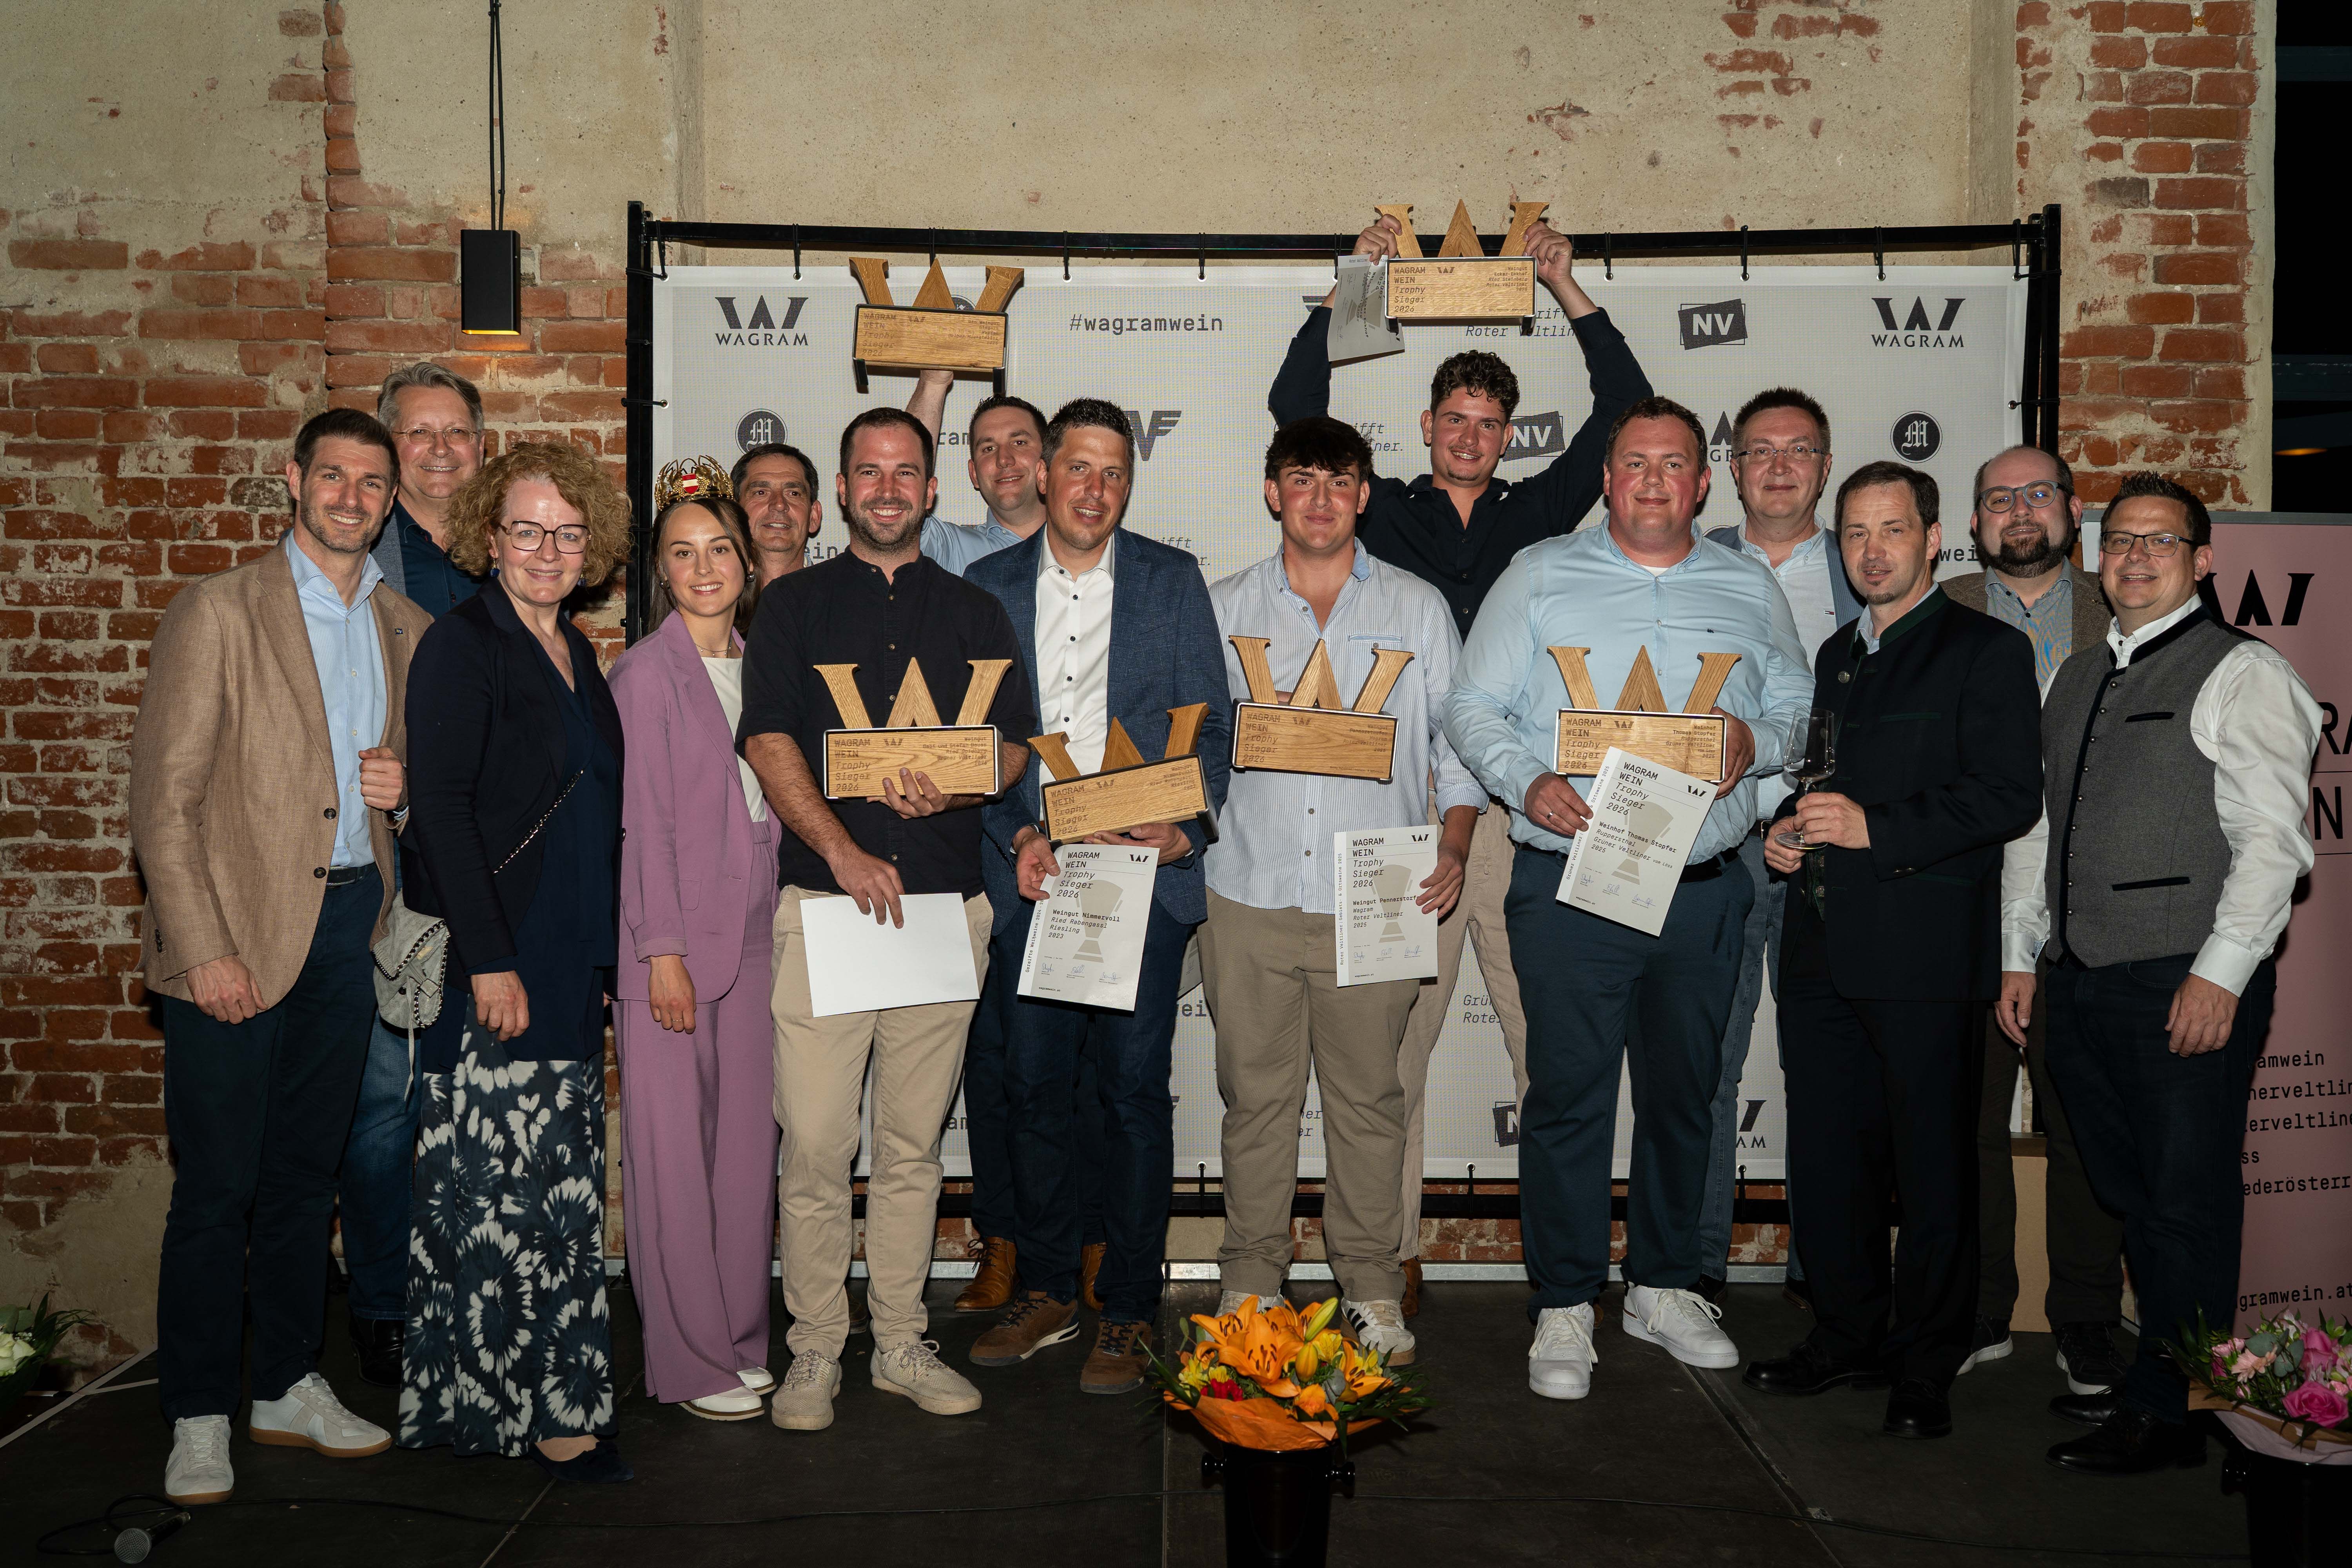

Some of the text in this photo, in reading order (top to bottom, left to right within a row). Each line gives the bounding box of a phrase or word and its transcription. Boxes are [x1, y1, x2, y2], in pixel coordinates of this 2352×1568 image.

[1070, 314, 1222, 335] #wagramwein
[1693, 314, 1734, 335] NV
[1466, 326, 1508, 336] Roter
[715, 333, 808, 345] WAGRAM
[1871, 334, 1964, 347] WAGRAM
[1353, 423, 1385, 434] ifft
[1511, 426, 1552, 447] NV
[1247, 713, 1280, 722] WAGRAM
[1566, 718, 1601, 726] WAGRAM
[1246, 722, 1268, 732] WEIN
[1566, 728, 1589, 737] WEIN
[835, 739, 870, 747] WAGRAM
[1245, 733, 1279, 744] Trophy
[1244, 744, 1278, 754] Sieger
[1566, 739, 1600, 750] Trophy
[835, 750, 859, 758] WEIN
[1243, 754, 1265, 763] 2026
[1565, 750, 1600, 760] Sieger
[836, 761, 871, 769] Trophy
[1564, 760, 1587, 769] 2026
[1623, 762, 1658, 780] WAGRAM
[835, 772, 871, 781] Sieger
[1619, 771, 1643, 786] WEIN
[835, 784, 858, 792] 2026
[1051, 785, 1085, 798] WAGRAM
[1615, 782, 1649, 800] Trophy
[1052, 797, 1074, 807] WEIN
[1611, 792, 1645, 810] Sieger
[1054, 805, 1087, 817] Trophy
[1606, 802, 1630, 815] 2026
[1055, 814, 1088, 826] Sieger
[1057, 825, 1078, 835] 2026
[1352, 837, 1384, 846] WAGRAM
[1596, 829, 1635, 847] Ruppersthal
[1599, 821, 1677, 853] Weinhof Thomas Stopfer
[1352, 849, 1374, 857] WEIN
[1591, 844, 1606, 853] 2025
[1619, 845, 1651, 861] Veltliner
[1353, 858, 1384, 867] Trophy
[1063, 871, 1096, 880] Trophy
[1353, 869, 1384, 878] Sieger
[1060, 880, 1093, 889] Sieger
[1353, 879, 1373, 888] 2026
[1057, 889, 1080, 898] 2026
[1053, 909, 1120, 922] Weingut Nimmervoll
[1070, 919, 1107, 928] Rabengassl
[1050, 924, 1080, 934] Riesling
[1463, 995, 1492, 1005] Grü
[1463, 1012, 1501, 1023] Rote
[2258, 1050, 2324, 1068] amwein
[2243, 1176, 2351, 1196] ederösterr
[2237, 1283, 2352, 1312] gramwein.at
